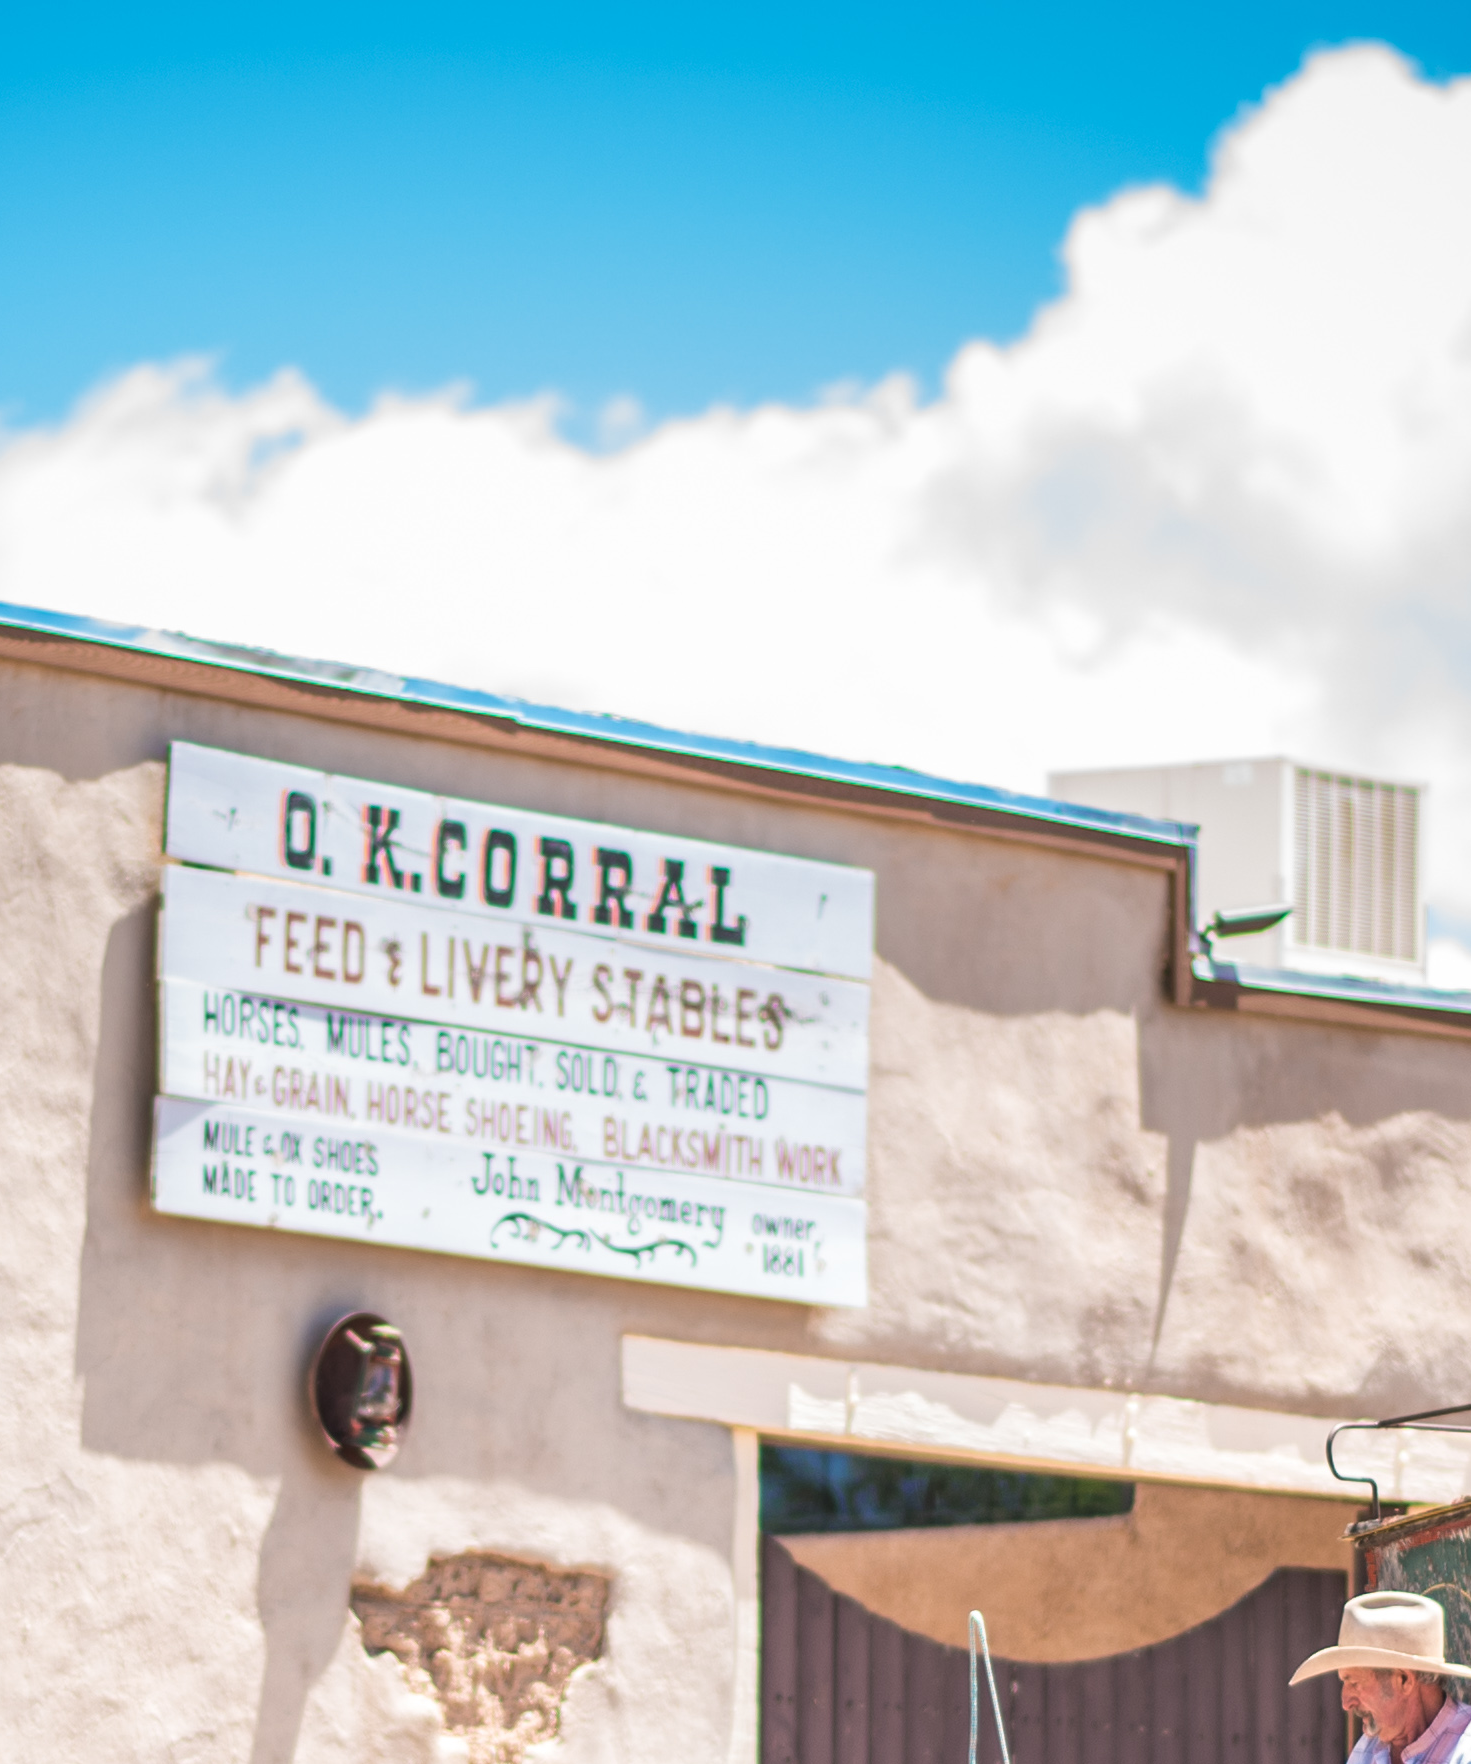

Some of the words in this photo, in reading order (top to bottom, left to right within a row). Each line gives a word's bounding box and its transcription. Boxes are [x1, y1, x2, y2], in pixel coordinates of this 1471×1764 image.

[252, 905, 367, 984] FEED
[421, 931, 573, 1020] LIVERY
[592, 962, 784, 1052] STABLES
[203, 1050, 251, 1100] HAY
[254, 1074, 267, 1096] &
[367, 1080, 452, 1134] HORSE
[603, 1114, 762, 1177] BLACKSMITH
[775, 1136, 843, 1187] WORK
[633, 1070, 648, 1101] &
[666, 1065, 768, 1120] TRADED
[203, 1120, 256, 1157] MULE
[263, 1135, 275, 1156] &
[281, 1131, 302, 1164] OX
[312, 1136, 379, 1177] SHOES
[203, 1161, 257, 1202] MADE
[271, 1173, 295, 1207] TO
[471, 1151, 540, 1202] John
[555, 1163, 727, 1249] Montgomery
[762, 1242, 804, 1278] 1881
